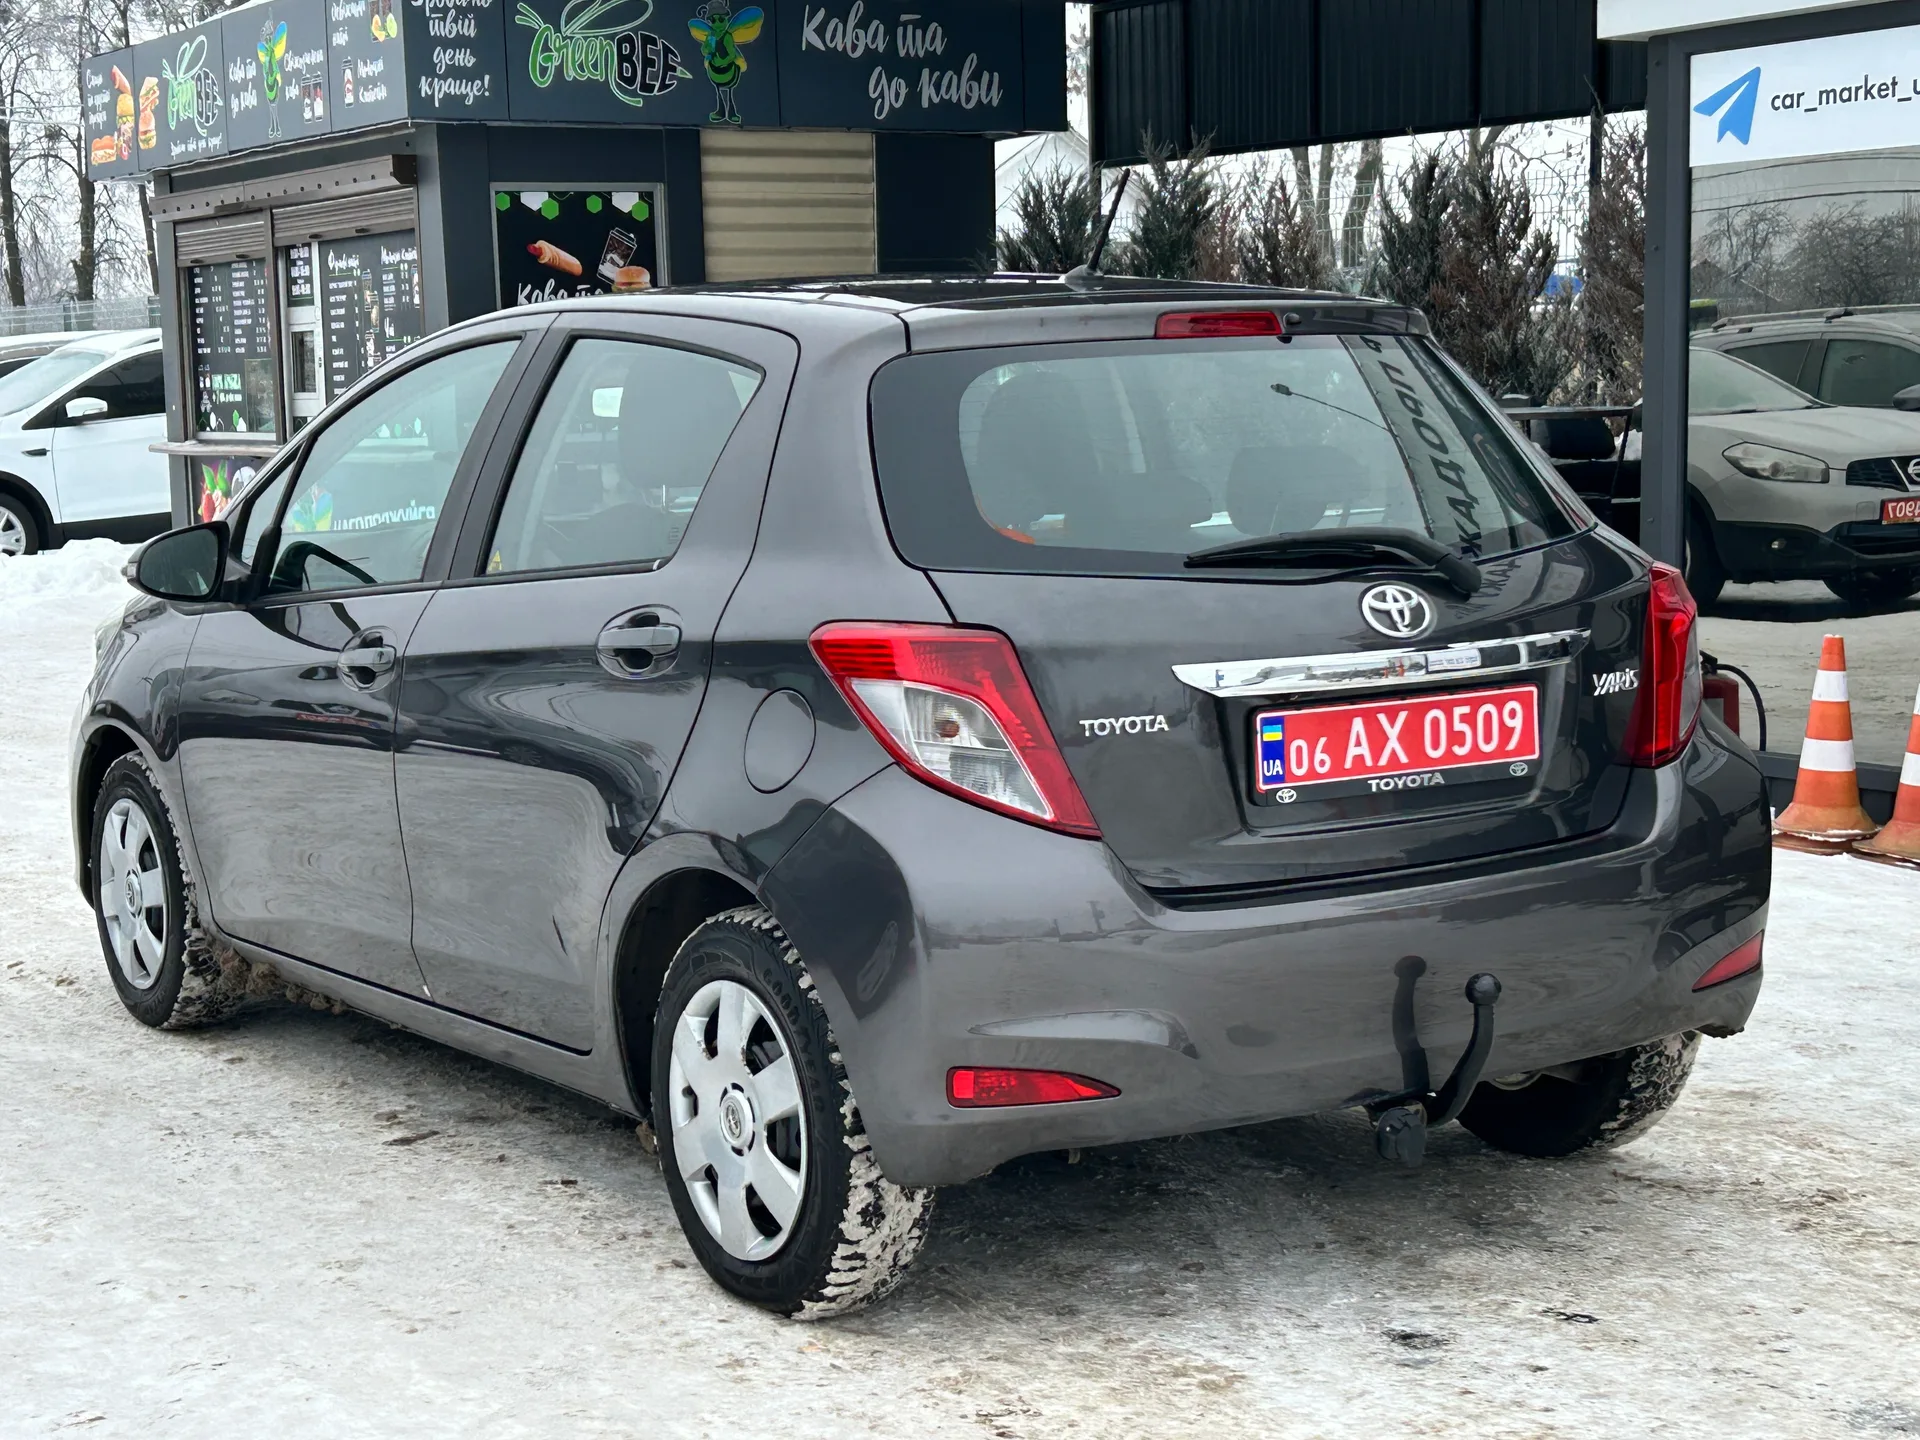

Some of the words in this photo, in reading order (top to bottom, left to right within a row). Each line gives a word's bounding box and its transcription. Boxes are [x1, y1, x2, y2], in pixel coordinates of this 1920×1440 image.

[429, 8, 477, 38] твій
[801, 0, 889, 59] Кава
[896, 14, 947, 58] та
[433, 46, 476, 74] день
[418, 74, 490, 107] краще!
[868, 66, 909, 120] до
[917, 52, 1004, 110] кави
[1079, 714, 1169, 737] TOYOTA
[1290, 737, 1332, 777] 06
[1343, 712, 1408, 770] AX
[1423, 700, 1523, 760] 0509
[1263, 759, 1282, 776] UA
[1367, 772, 1445, 793] TOYOTA
